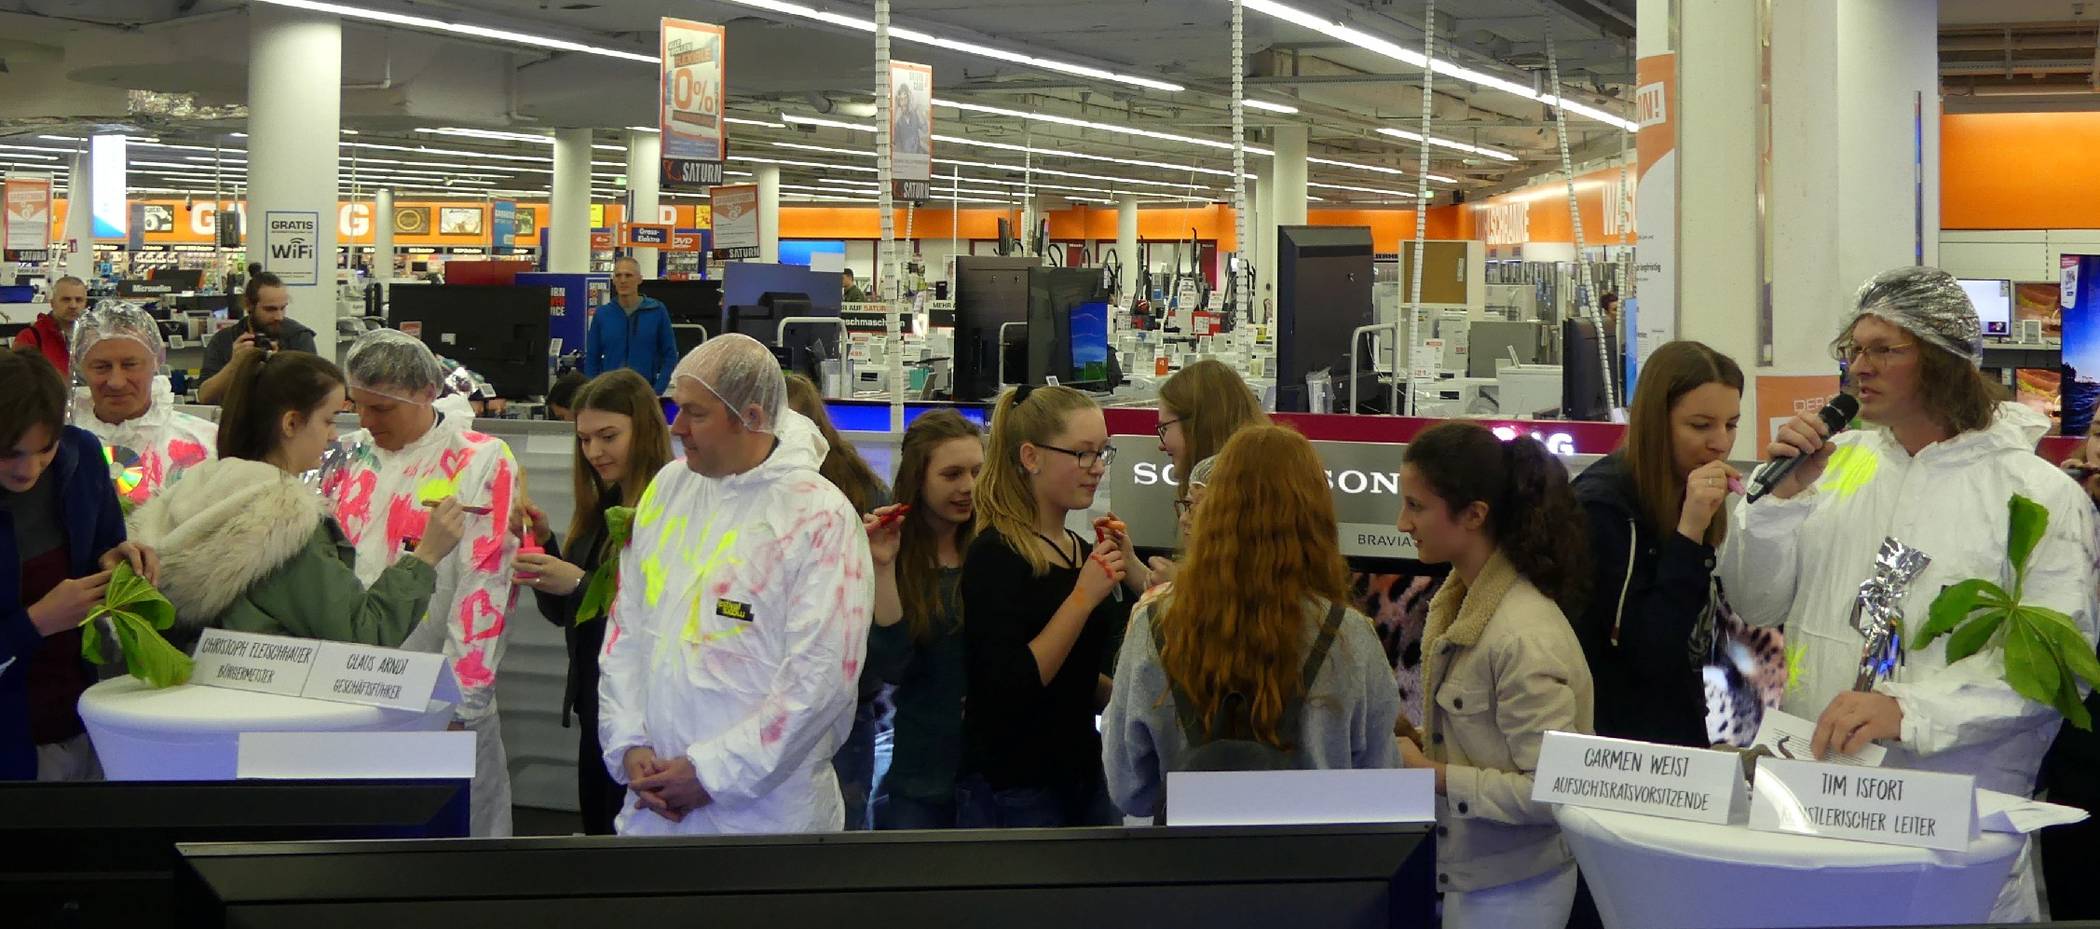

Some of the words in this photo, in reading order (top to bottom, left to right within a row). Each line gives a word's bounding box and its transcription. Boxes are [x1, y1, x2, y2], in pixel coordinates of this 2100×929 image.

[674, 67, 713, 113] 0%
[682, 162, 722, 183] SATURN
[904, 182, 930, 199] SATURN
[271, 220, 314, 231] GRATIS
[271, 243, 313, 260] WiFi
[728, 246, 760, 258] SATURN
[1357, 533, 1412, 547] BRAVIA
[201, 637, 249, 658] CHRISTOPH
[249, 642, 314, 664] FLEISCHHAUER
[346, 653, 376, 672] CLAUS
[377, 656, 410, 676] ARNDT
[1584, 747, 1643, 772] CARMEN
[1650, 754, 1690, 778] WEIST
[1552, 776, 1712, 812] AUFSICHTSRATSVORSITZENDE
[1822, 772, 1848, 797] TIM
[1856, 776, 1905, 801] ISFORT
[1784, 803, 1887, 832] STLERISCHER
[1894, 814, 1936, 837] LEITER
